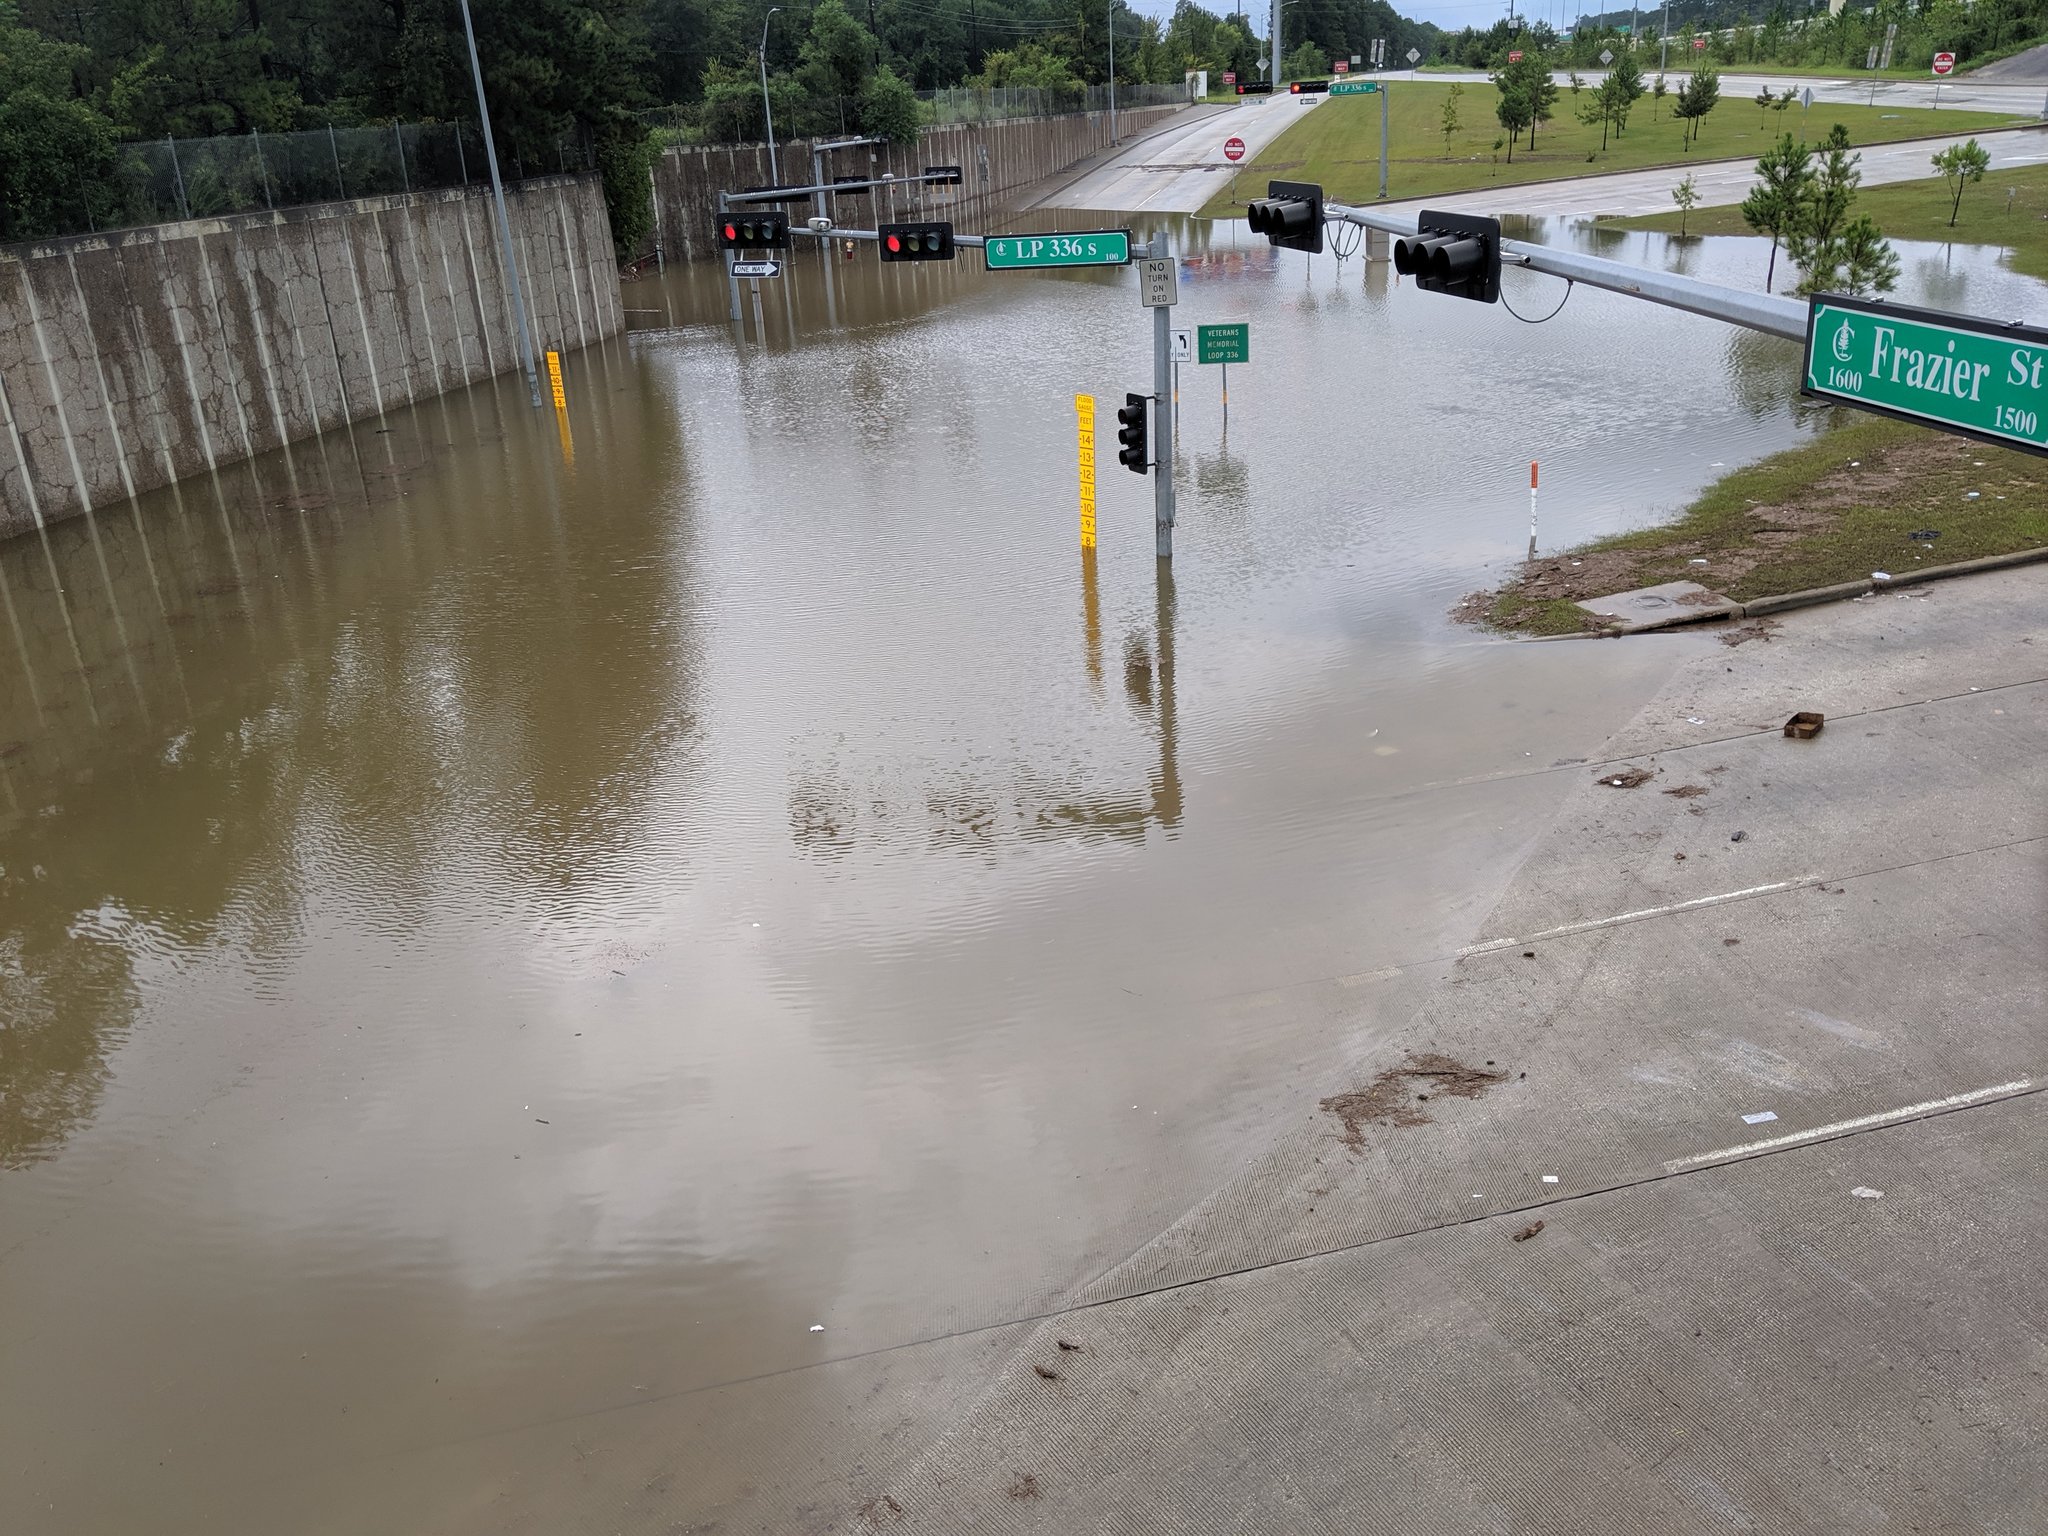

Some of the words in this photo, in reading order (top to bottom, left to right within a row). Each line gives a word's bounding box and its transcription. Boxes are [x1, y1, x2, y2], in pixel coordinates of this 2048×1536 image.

[1016, 240, 1044, 258] LP
[1049, 238, 1082, 258] 336
[1105, 252, 1118, 261] 100
[1150, 262, 1164, 272] NO
[1148, 274, 1168, 282] TURN
[1152, 294, 1168, 302] RED
[1869, 326, 1990, 402] Frazier
[2006, 349, 2044, 389] St
[1828, 366, 1862, 392] 1600
[1080, 416, 1092, 424] FEET
[1994, 405, 2038, 436] 1500
[1082, 434, 1091, 445] 14
[1083, 452, 1091, 462] 13
[1083, 469, 1091, 480] 12
[1085, 486, 1091, 496] 11
[1084, 503, 1092, 513] 10
[1086, 520, 1090, 528] 9
[1086, 536, 1091, 546] 8
